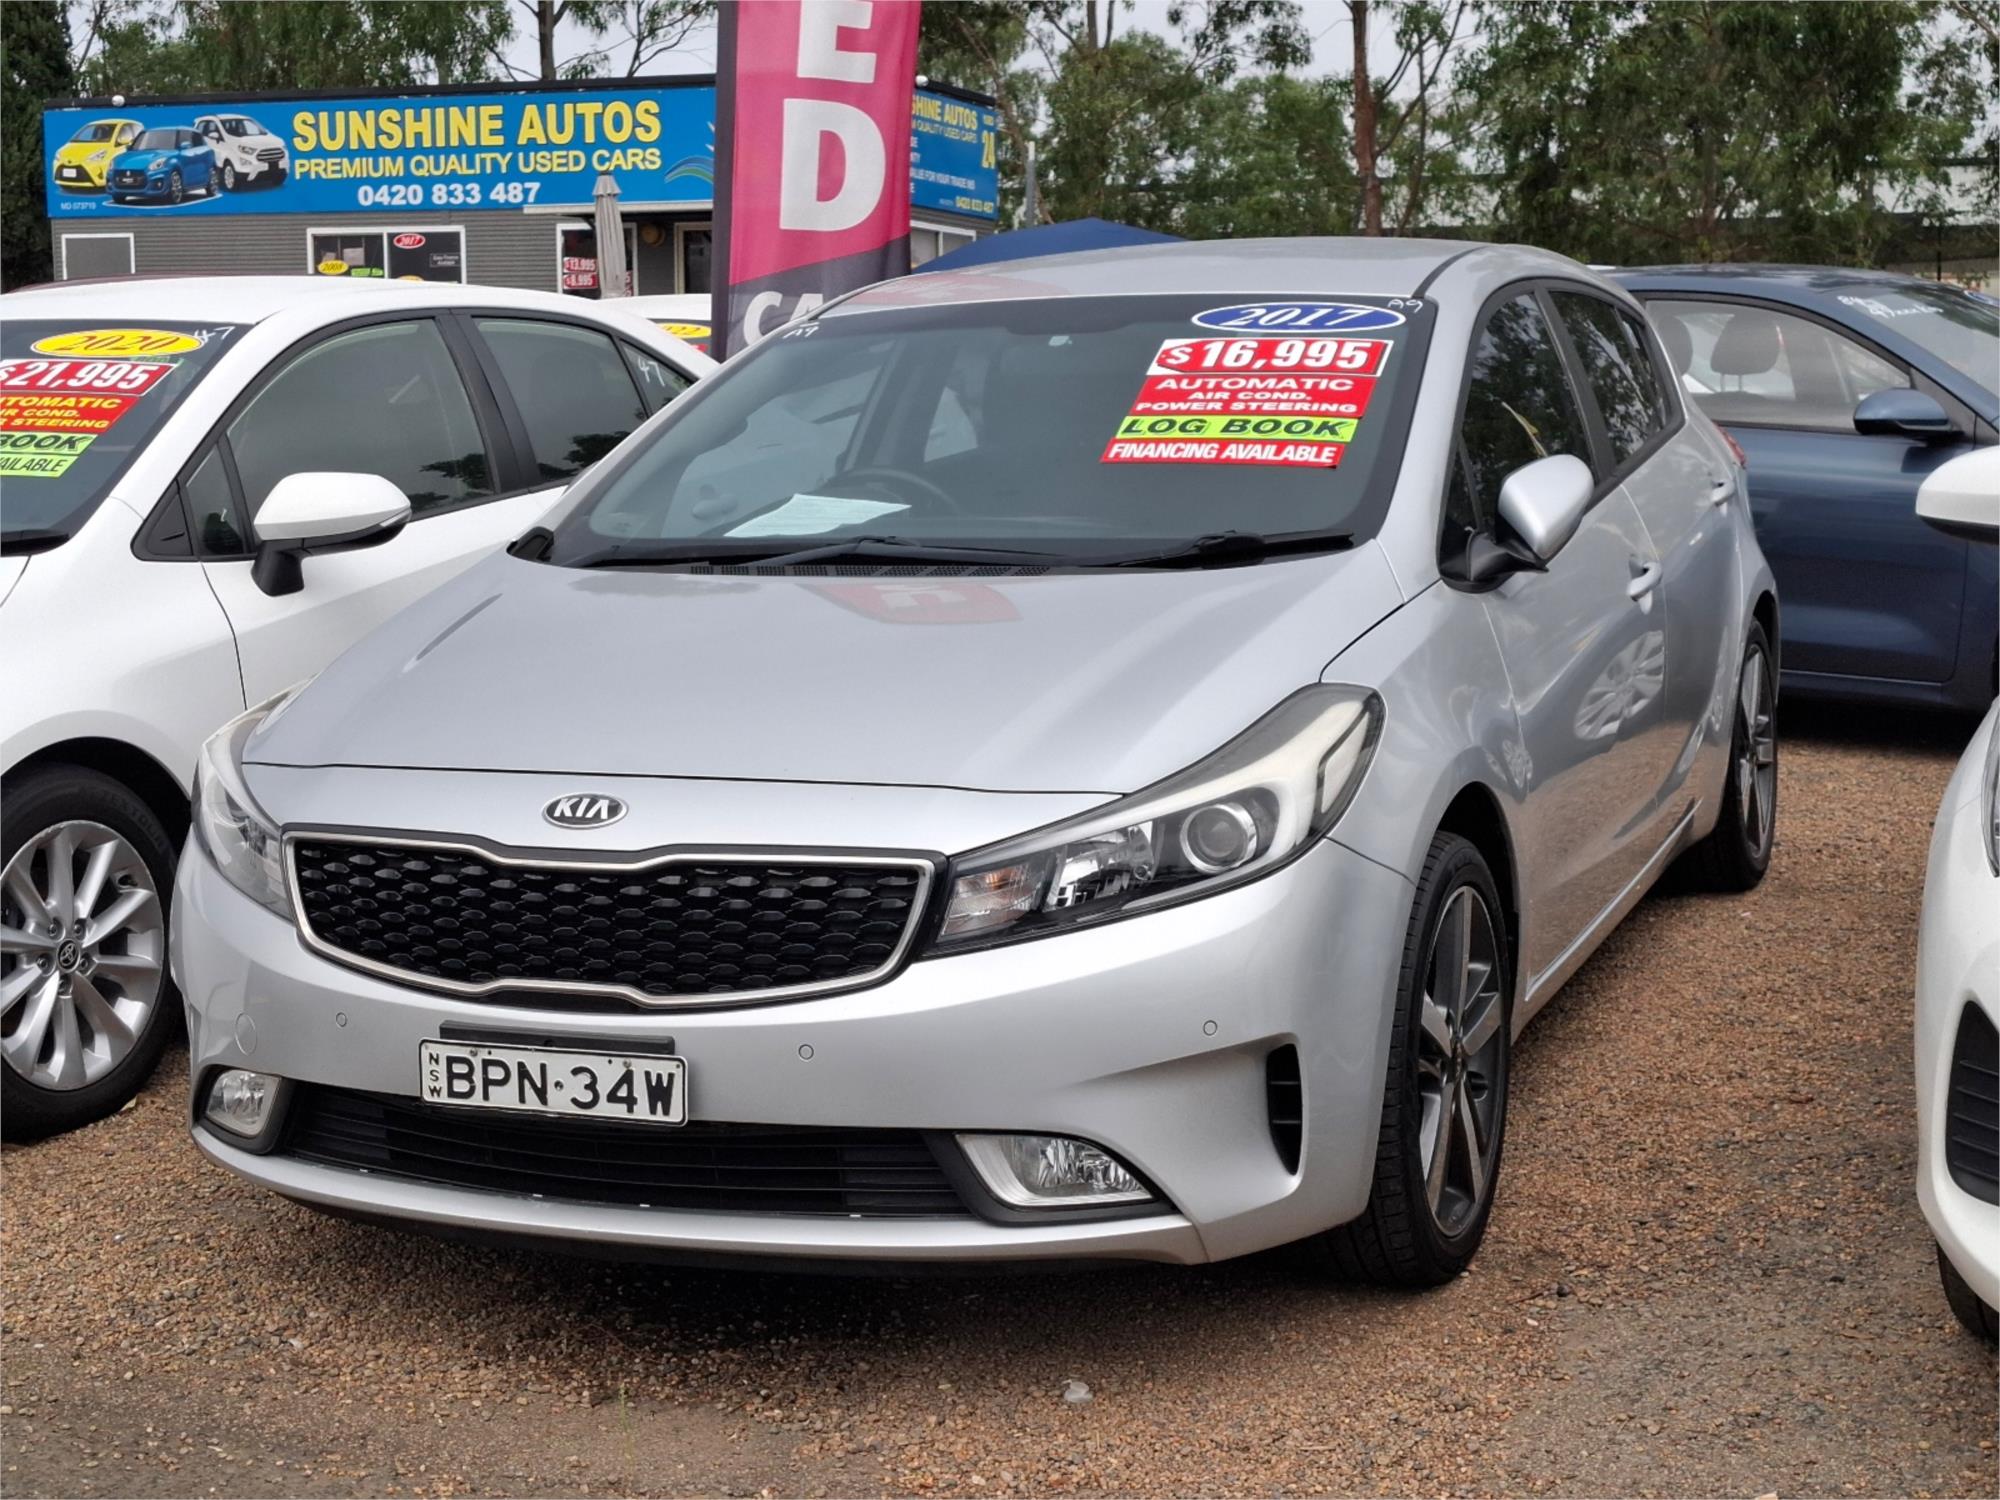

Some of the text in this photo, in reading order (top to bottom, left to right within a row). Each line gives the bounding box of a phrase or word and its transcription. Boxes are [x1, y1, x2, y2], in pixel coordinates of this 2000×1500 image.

[293, 100, 662, 151] SUNSHINE AUTOS
[943, 103, 977, 130] AUTOS
[295, 148, 662, 180] PREMIUM QUALITY USED CARS
[358, 182, 541, 206] 0420 833 487
[1219, 307, 1369, 327] 2017
[55, 334, 180, 352] 2020
[1164, 340, 1372, 370] $16,995
[1155, 377, 1354, 392] AUTOMATIC
[1187, 390, 1312, 401] AIR COND.
[22, 409, 80, 418] COND.
[1136, 402, 1358, 414] POWER STEERING
[10, 418, 109, 429] STEERING
[1121, 418, 1350, 437] LOG BOOK
[1108, 442, 1338, 463] FINANCING AVAILABLE
[553, 797, 609, 820] KIA
